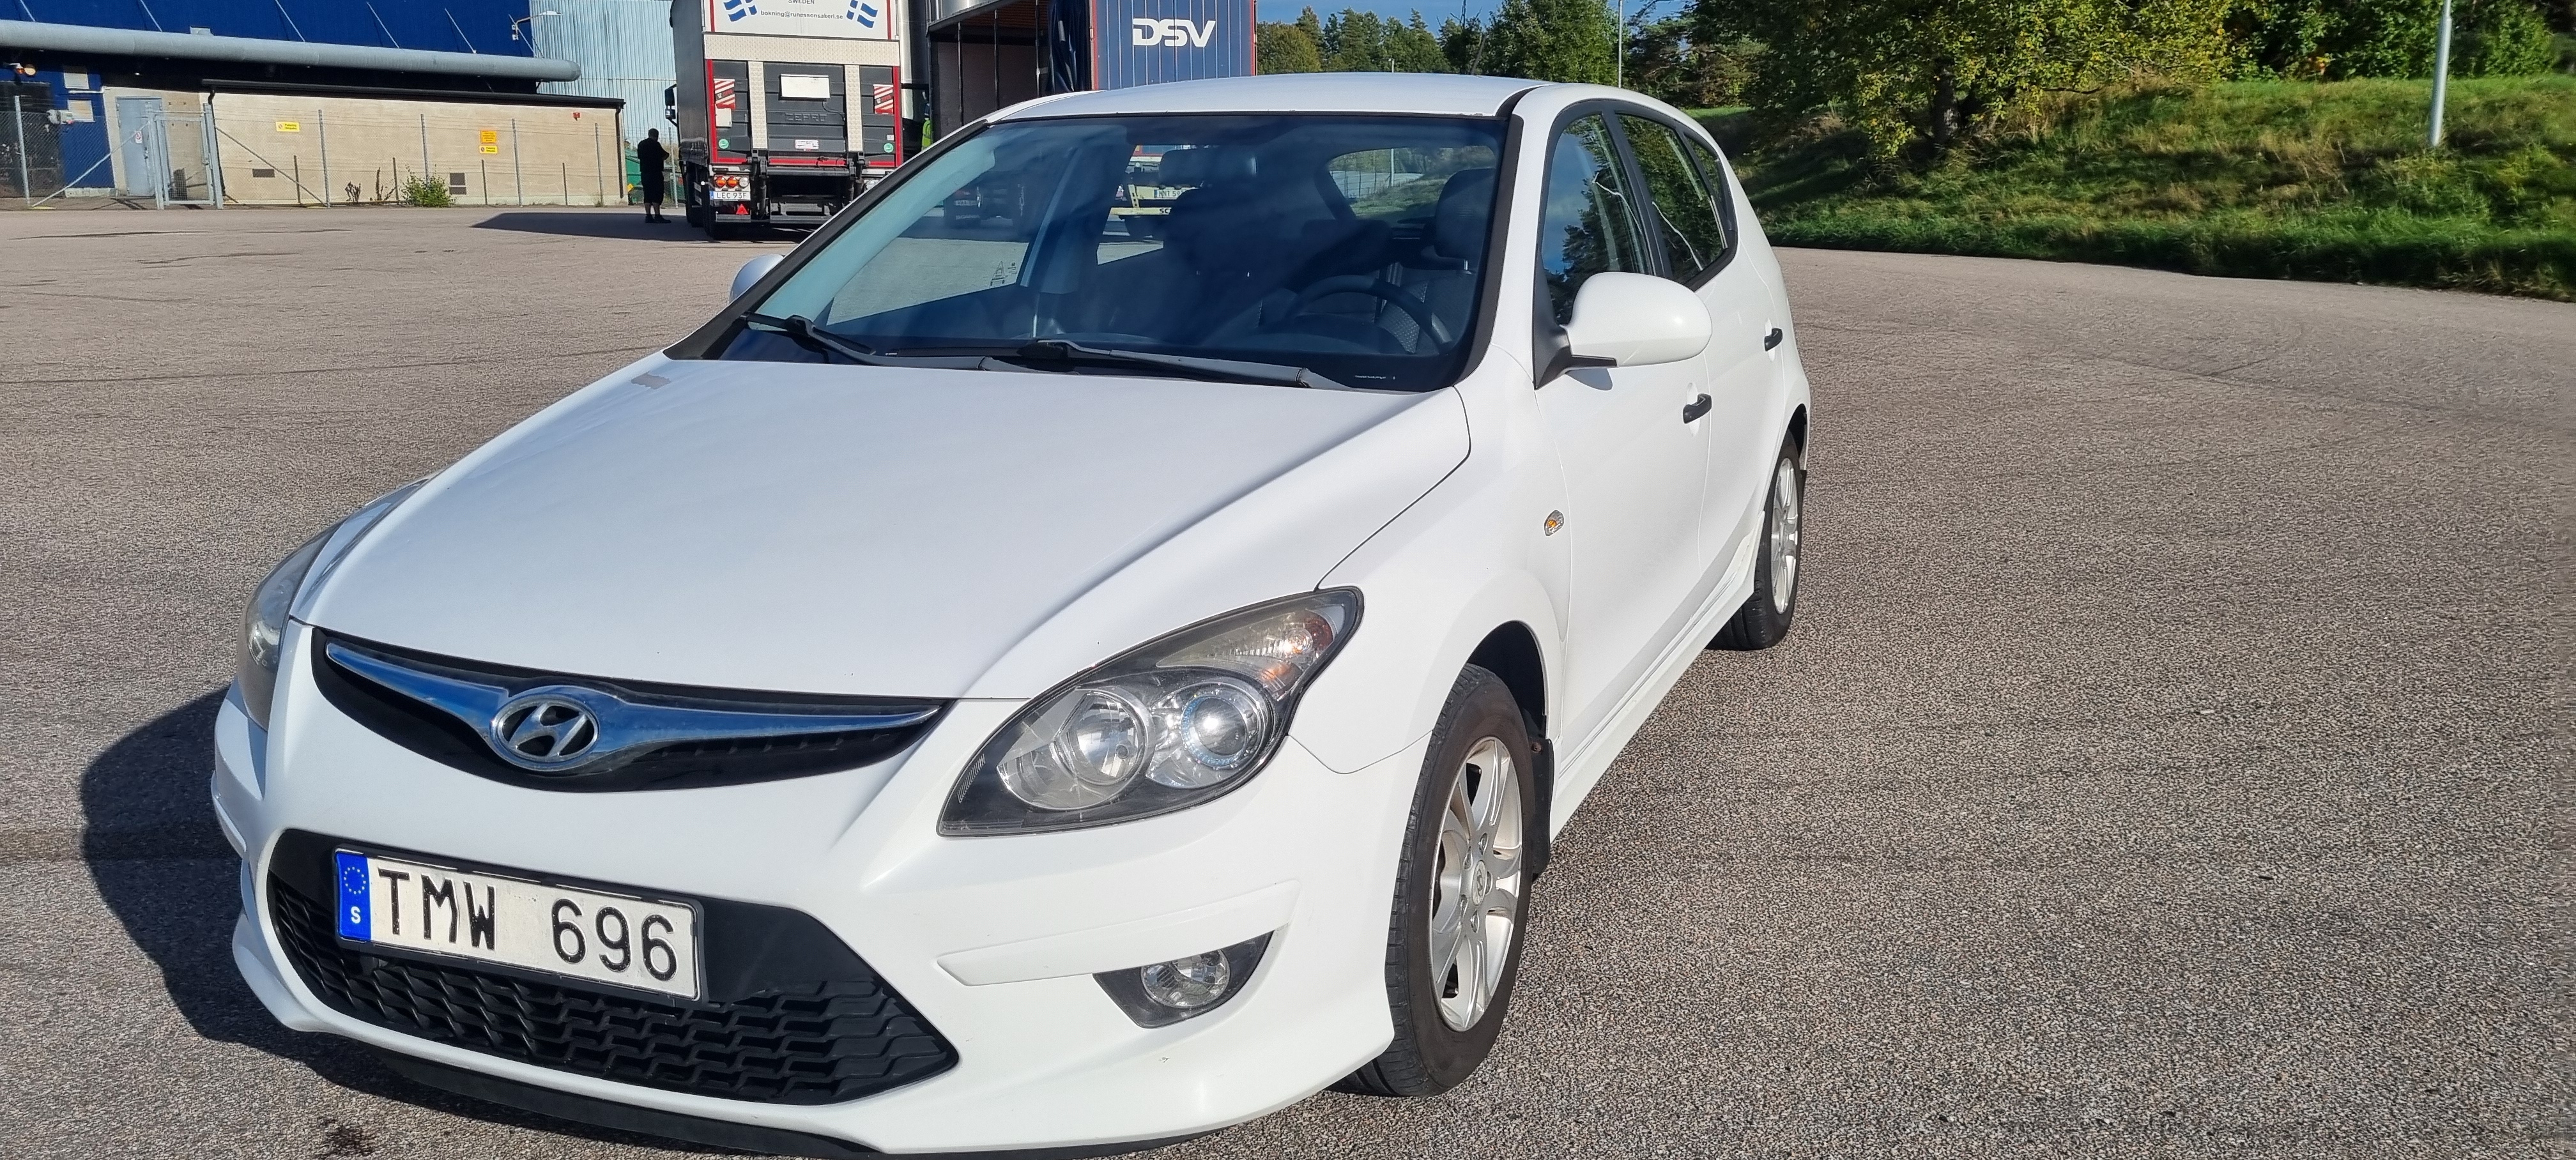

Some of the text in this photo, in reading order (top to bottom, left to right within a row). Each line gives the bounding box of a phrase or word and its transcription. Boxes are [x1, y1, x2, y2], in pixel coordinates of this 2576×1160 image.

[1133, 18, 1216, 47] DSV
[351, 867, 678, 981] S TMW 696
